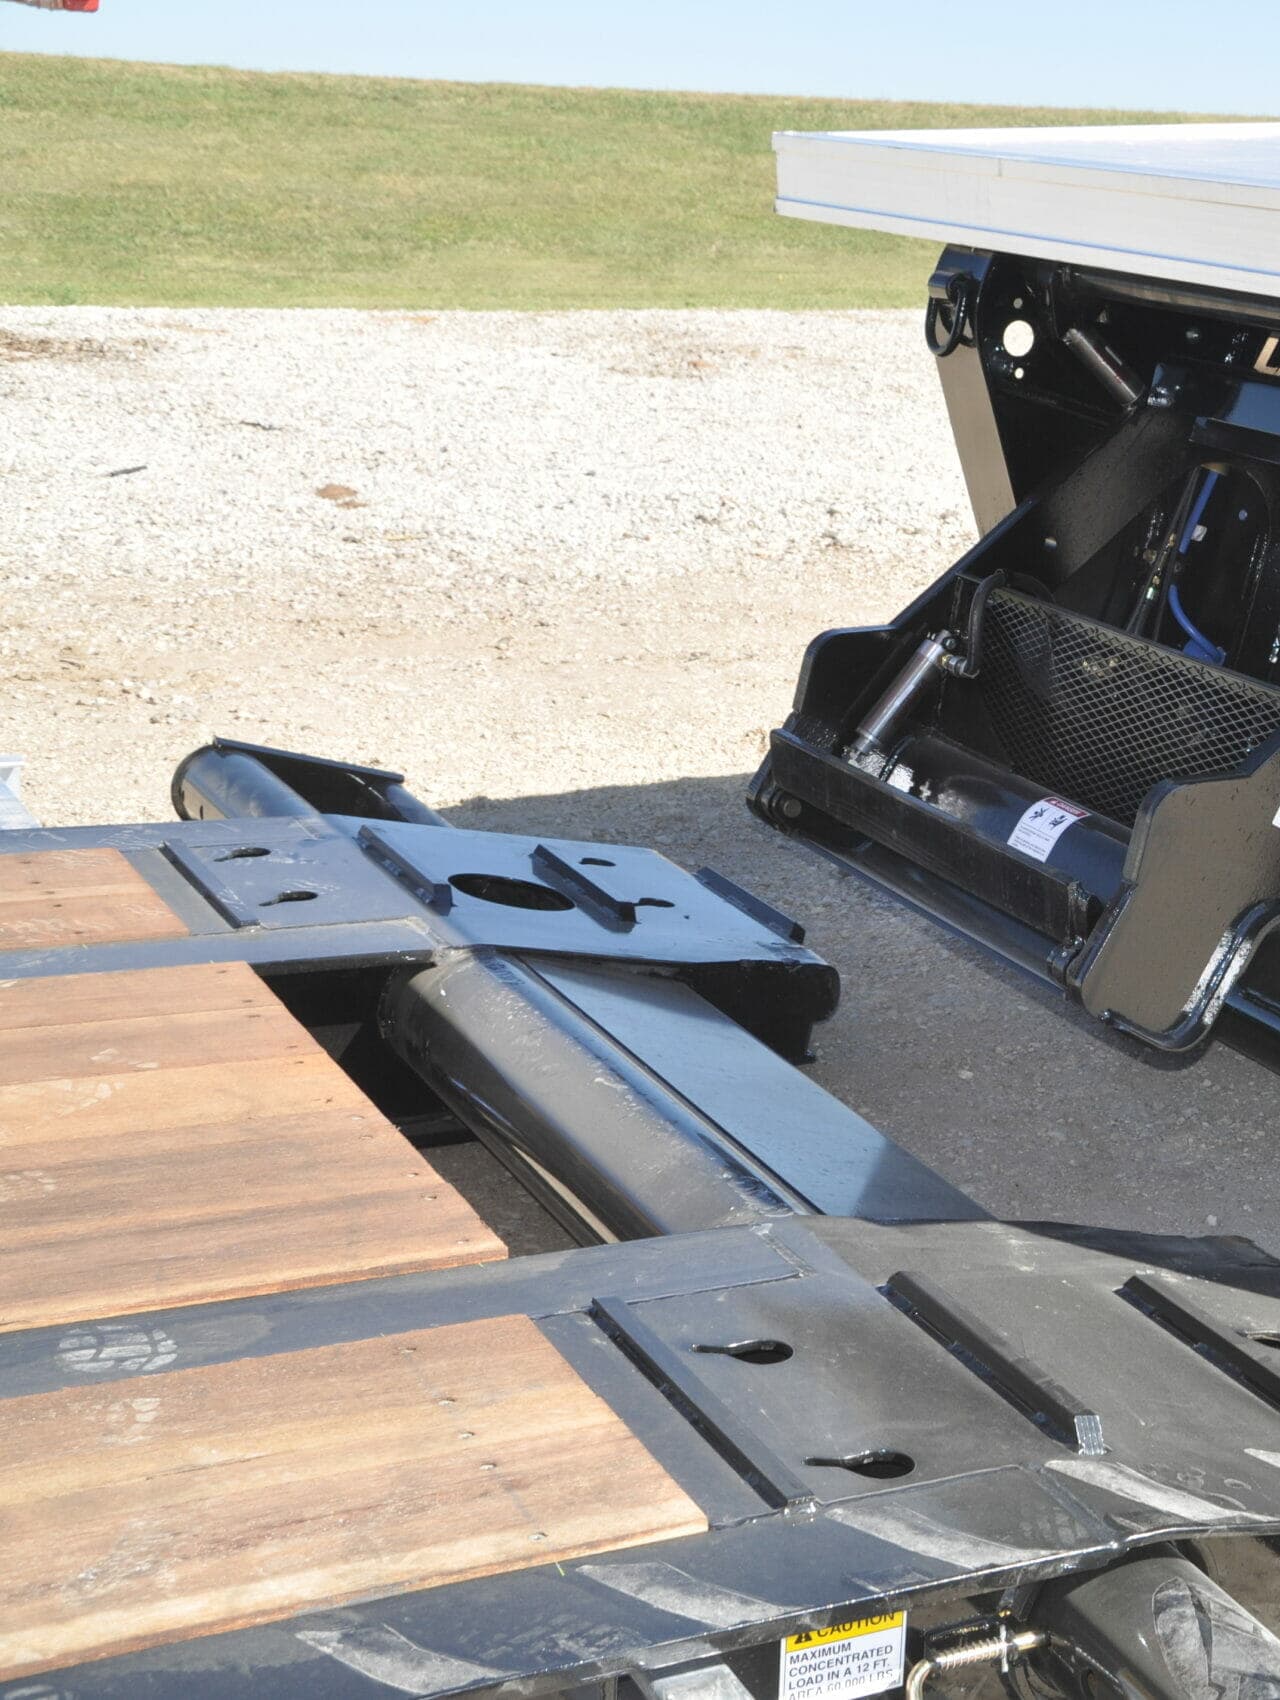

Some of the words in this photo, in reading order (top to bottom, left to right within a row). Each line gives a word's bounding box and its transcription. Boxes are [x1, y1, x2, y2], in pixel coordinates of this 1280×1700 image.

[788, 1645, 893, 1678] CONCENTRATED
[789, 1642, 851, 1665] MAXIMUM
[788, 1674, 823, 1690] LOAD
[827, 1670, 840, 1680] IN
[843, 1667, 852, 1677] A
[857, 1662, 870, 1673] 12
